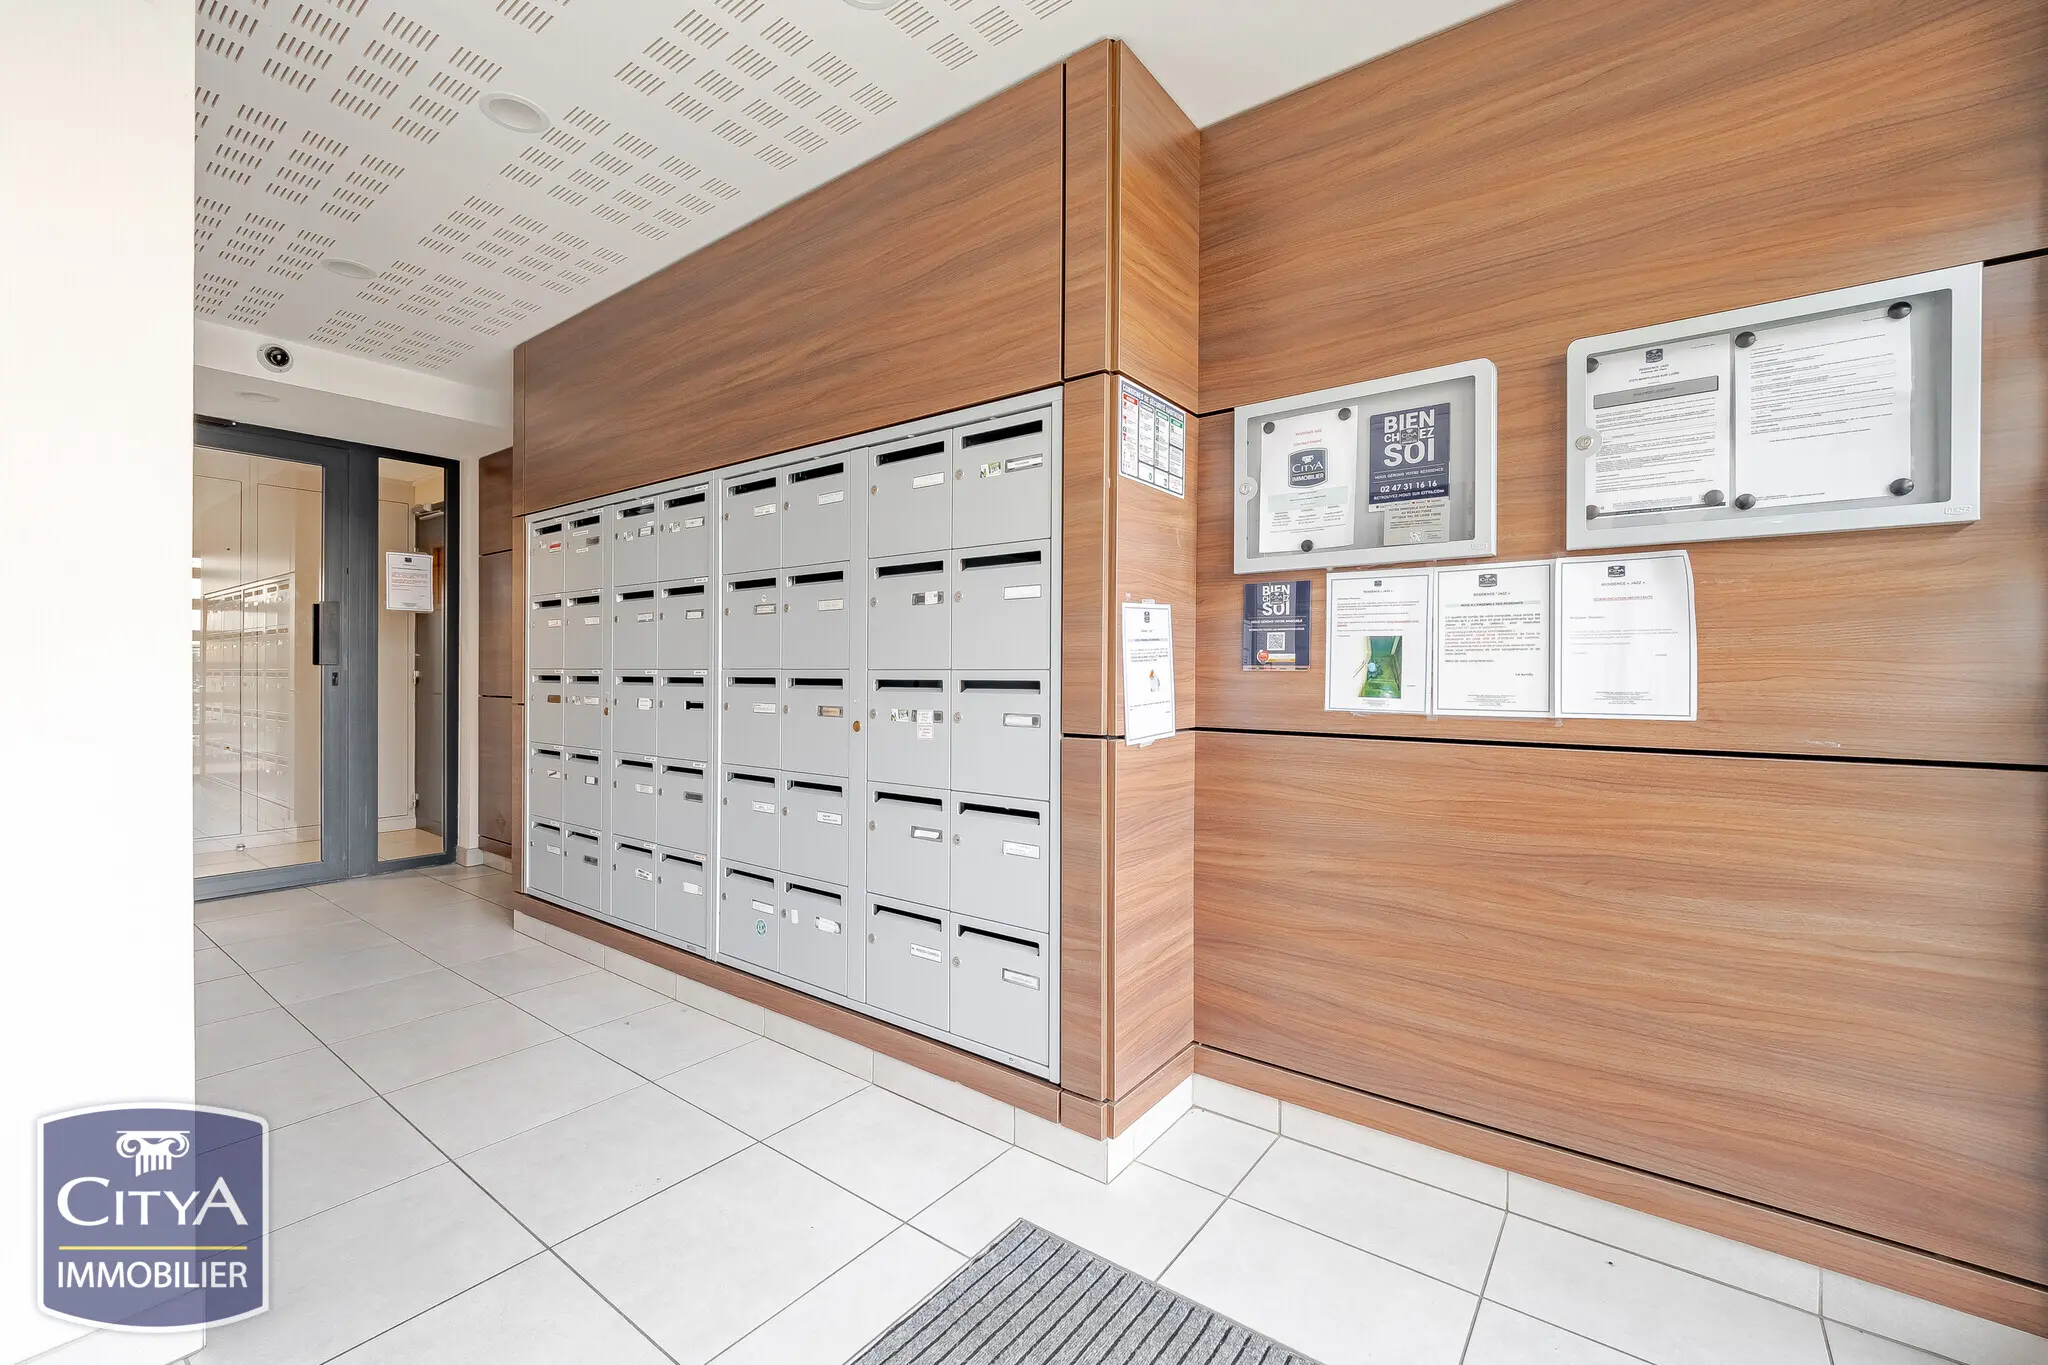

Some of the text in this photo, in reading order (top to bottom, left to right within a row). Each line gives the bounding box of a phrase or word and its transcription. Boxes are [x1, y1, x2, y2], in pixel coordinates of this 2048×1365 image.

[1384, 409, 1435, 433] BIEN
[1384, 438, 1435, 467] SOI
[1292, 461, 1324, 473] CITYA
[1292, 472, 1325, 482] IMMOBILIER
[1380, 485, 1390, 493] 02
[1428, 480, 1437, 488] 16
[1262, 601, 1290, 616] SOI
